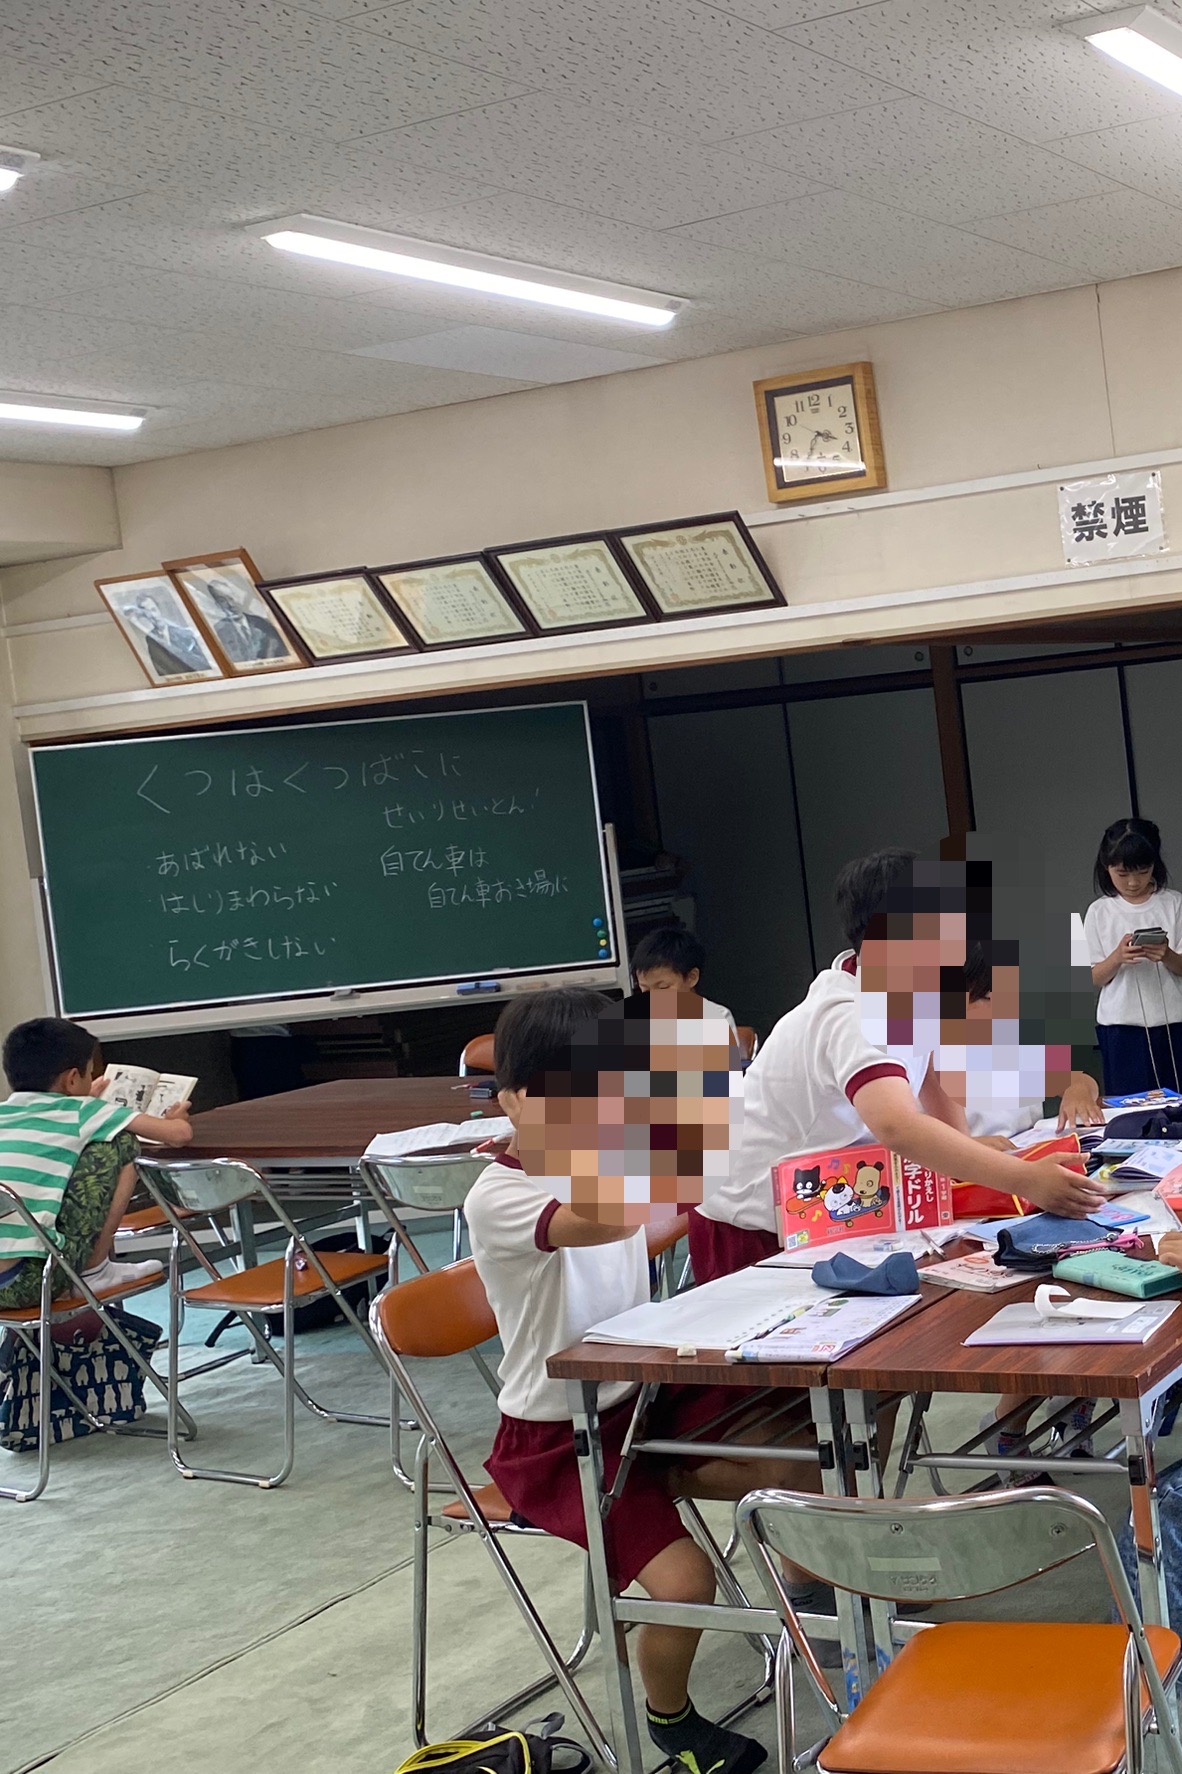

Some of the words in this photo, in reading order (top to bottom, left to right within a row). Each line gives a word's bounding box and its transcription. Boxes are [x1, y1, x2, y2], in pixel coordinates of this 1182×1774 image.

[795, 400, 805, 413] 11
[807, 394, 820, 407] 12
[827, 394, 832, 407] 1
[837, 406, 847, 418] 2
[784, 414, 797, 427] 10
[844, 422, 854, 434] 3
[782, 432, 791, 445] 9
[842, 440, 852, 453] 4
[1071, 495, 1149, 543] 禁煙
[136, 749, 462, 814] くつはくつばこに
[155, 841, 287, 877] あばれない
[380, 845, 490, 877] 自てん車は
[160, 881, 338, 915] はしりまわらない
[428, 869, 569, 909] 自てん車おき場に
[168, 935, 336, 971] らくがきしない
[904, 1158, 924, 1224] 字ドリル
[924, 1168, 934, 1202] りかえし
